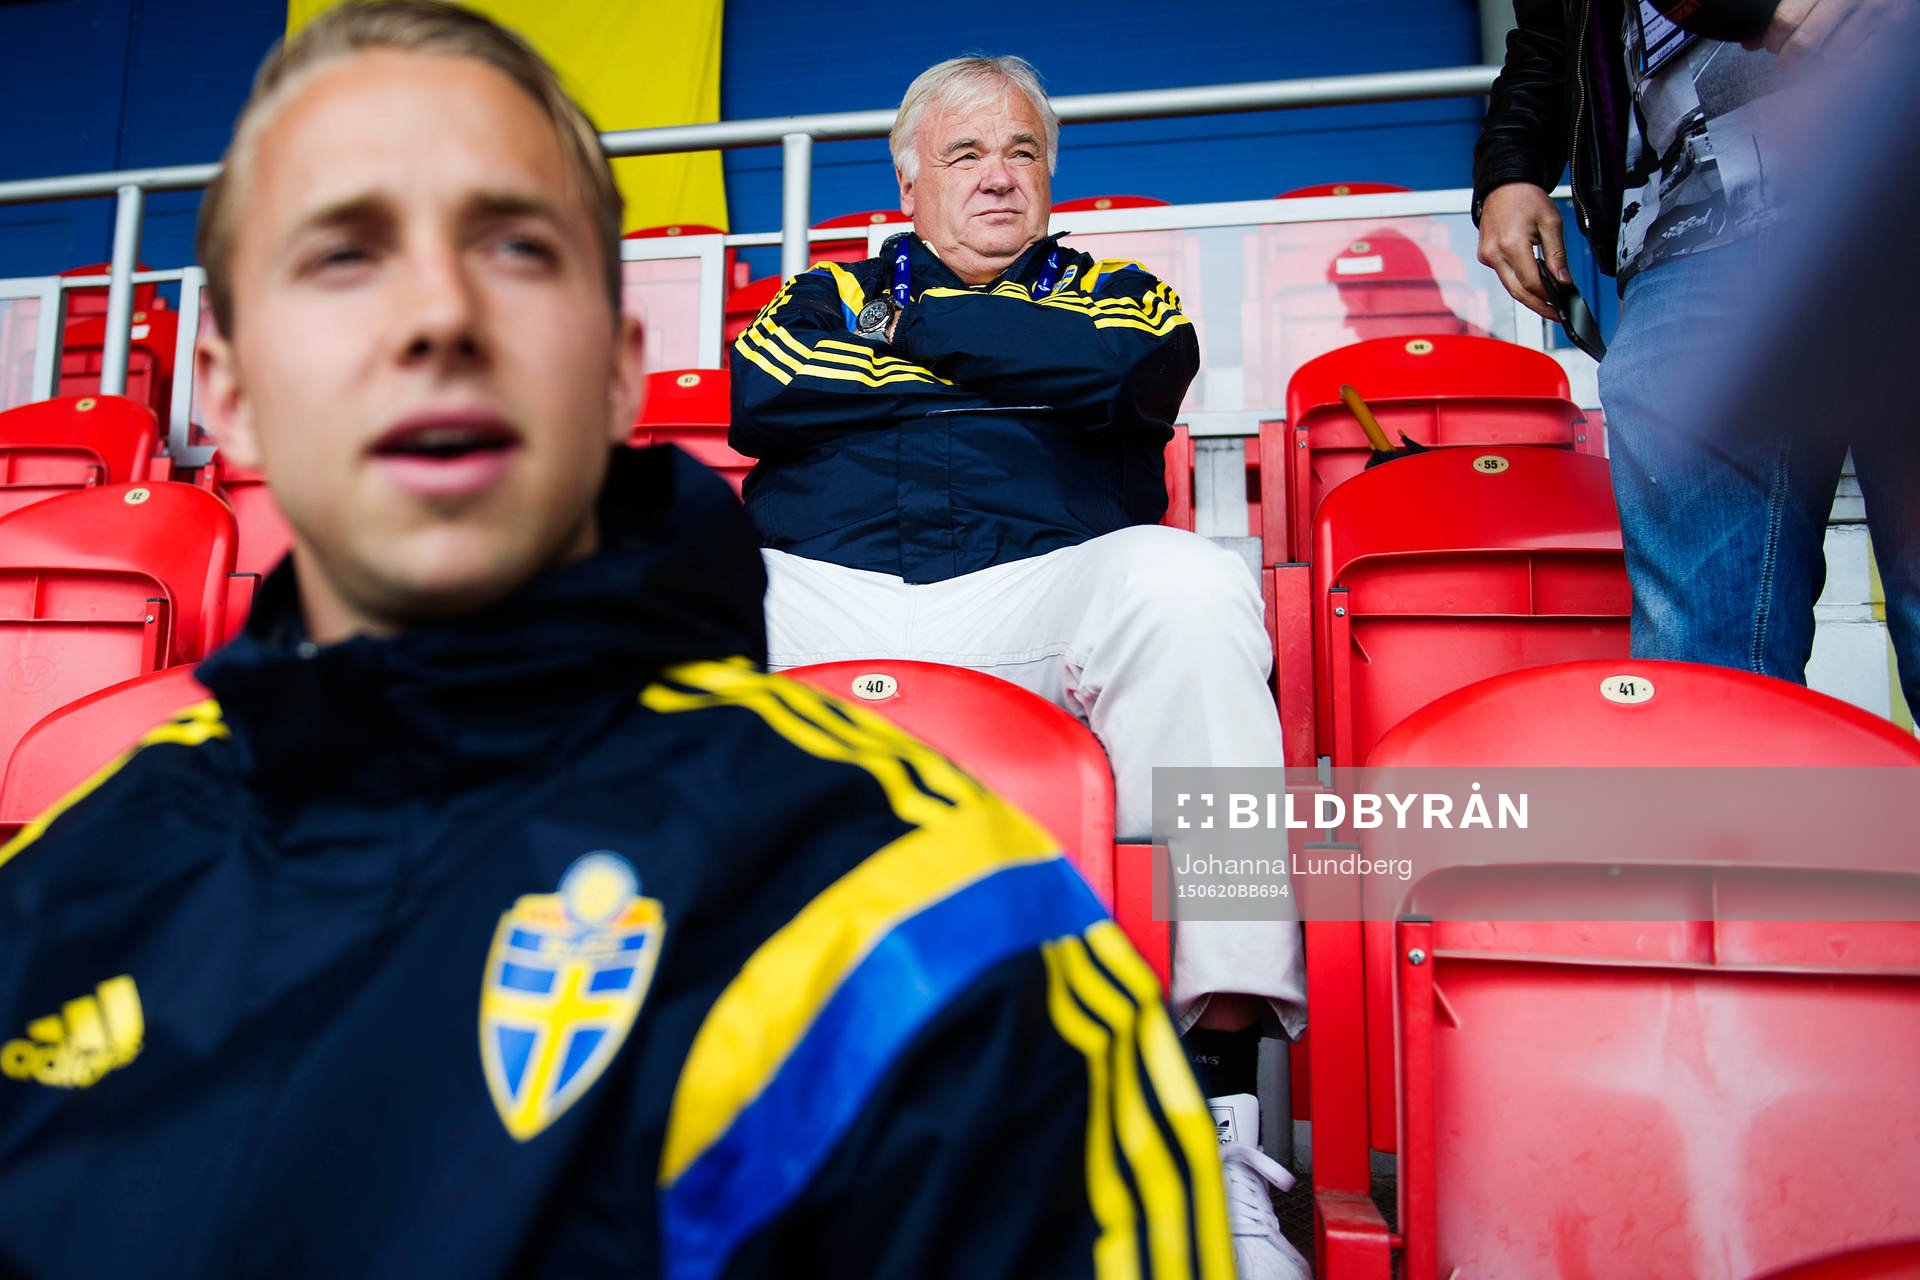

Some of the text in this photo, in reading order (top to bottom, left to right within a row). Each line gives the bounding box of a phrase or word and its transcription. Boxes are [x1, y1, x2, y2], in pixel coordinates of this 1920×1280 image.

[1484, 460, 1498, 469] 55
[866, 680, 884, 693] 40
[1619, 682, 1635, 696] 41
